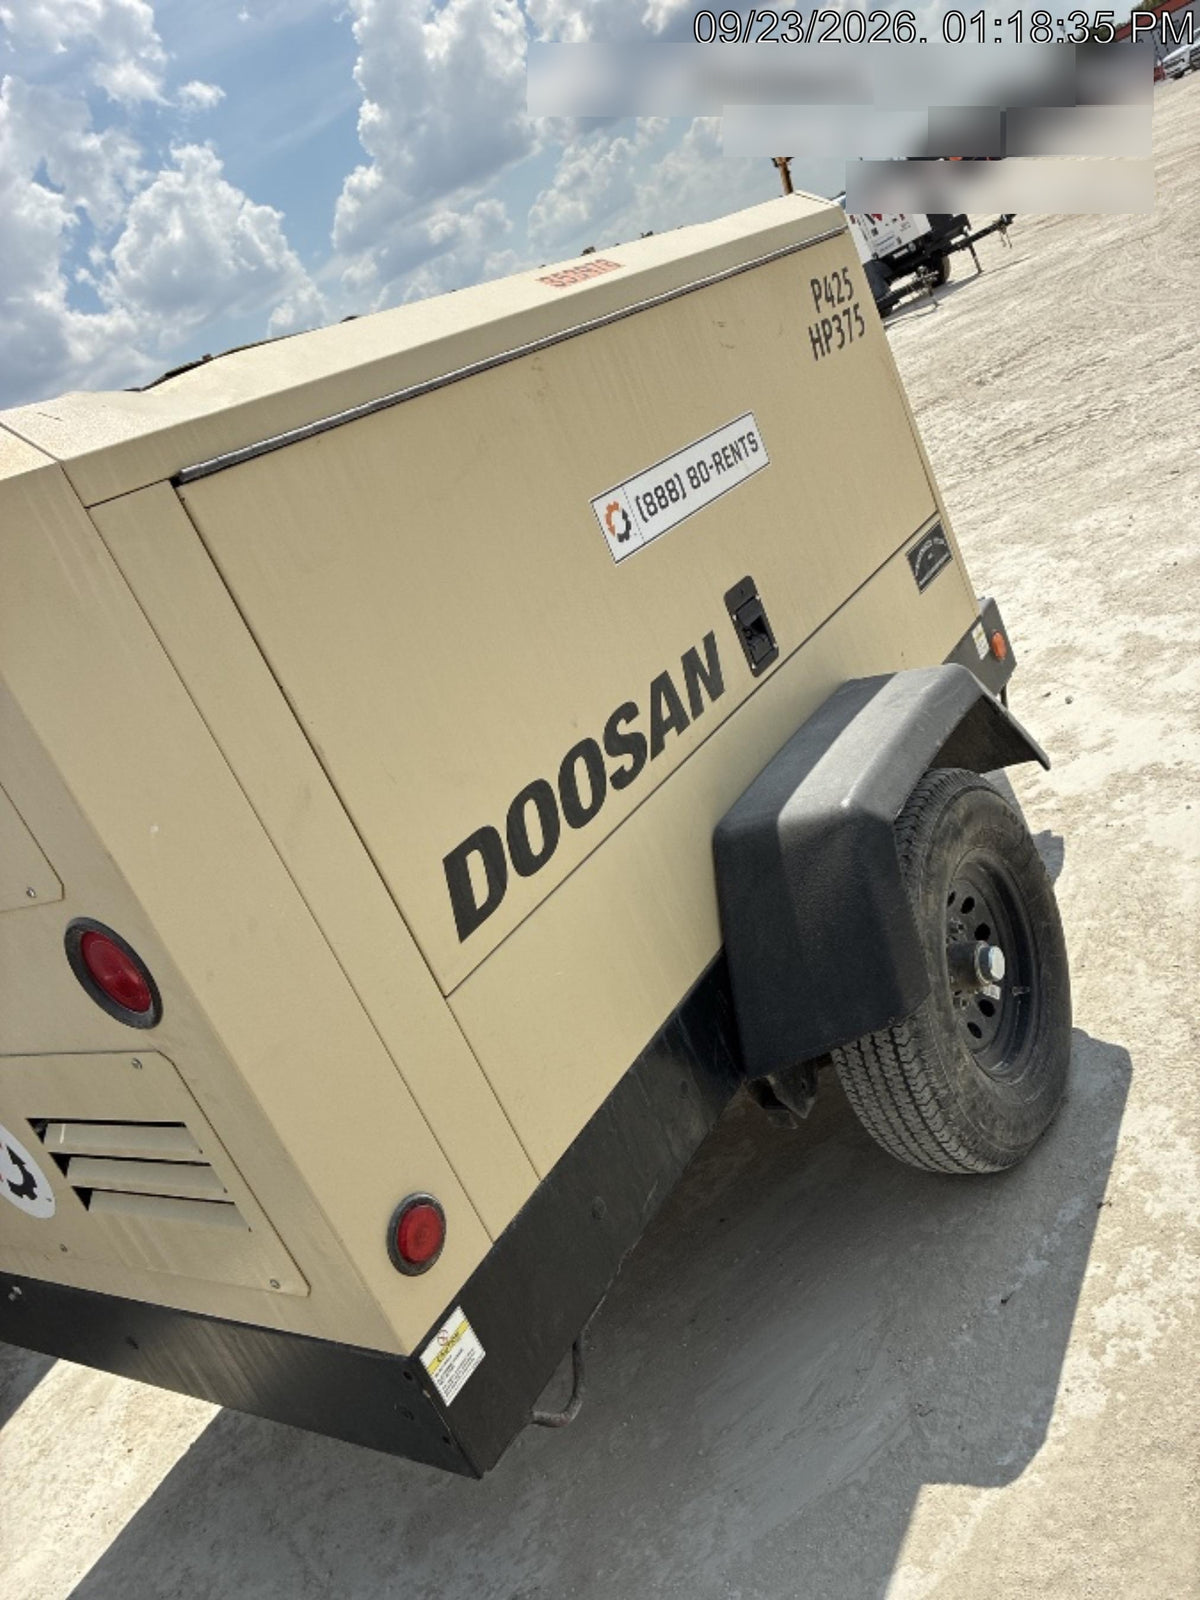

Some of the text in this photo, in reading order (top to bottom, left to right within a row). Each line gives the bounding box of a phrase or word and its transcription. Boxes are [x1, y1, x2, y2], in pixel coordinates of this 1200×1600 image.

[810, 266, 854, 314] P425
[808, 302, 865, 361] HP375
[635, 431, 759, 523] (888) 80-RENTS
[442, 630, 725, 944] DOOSAN
